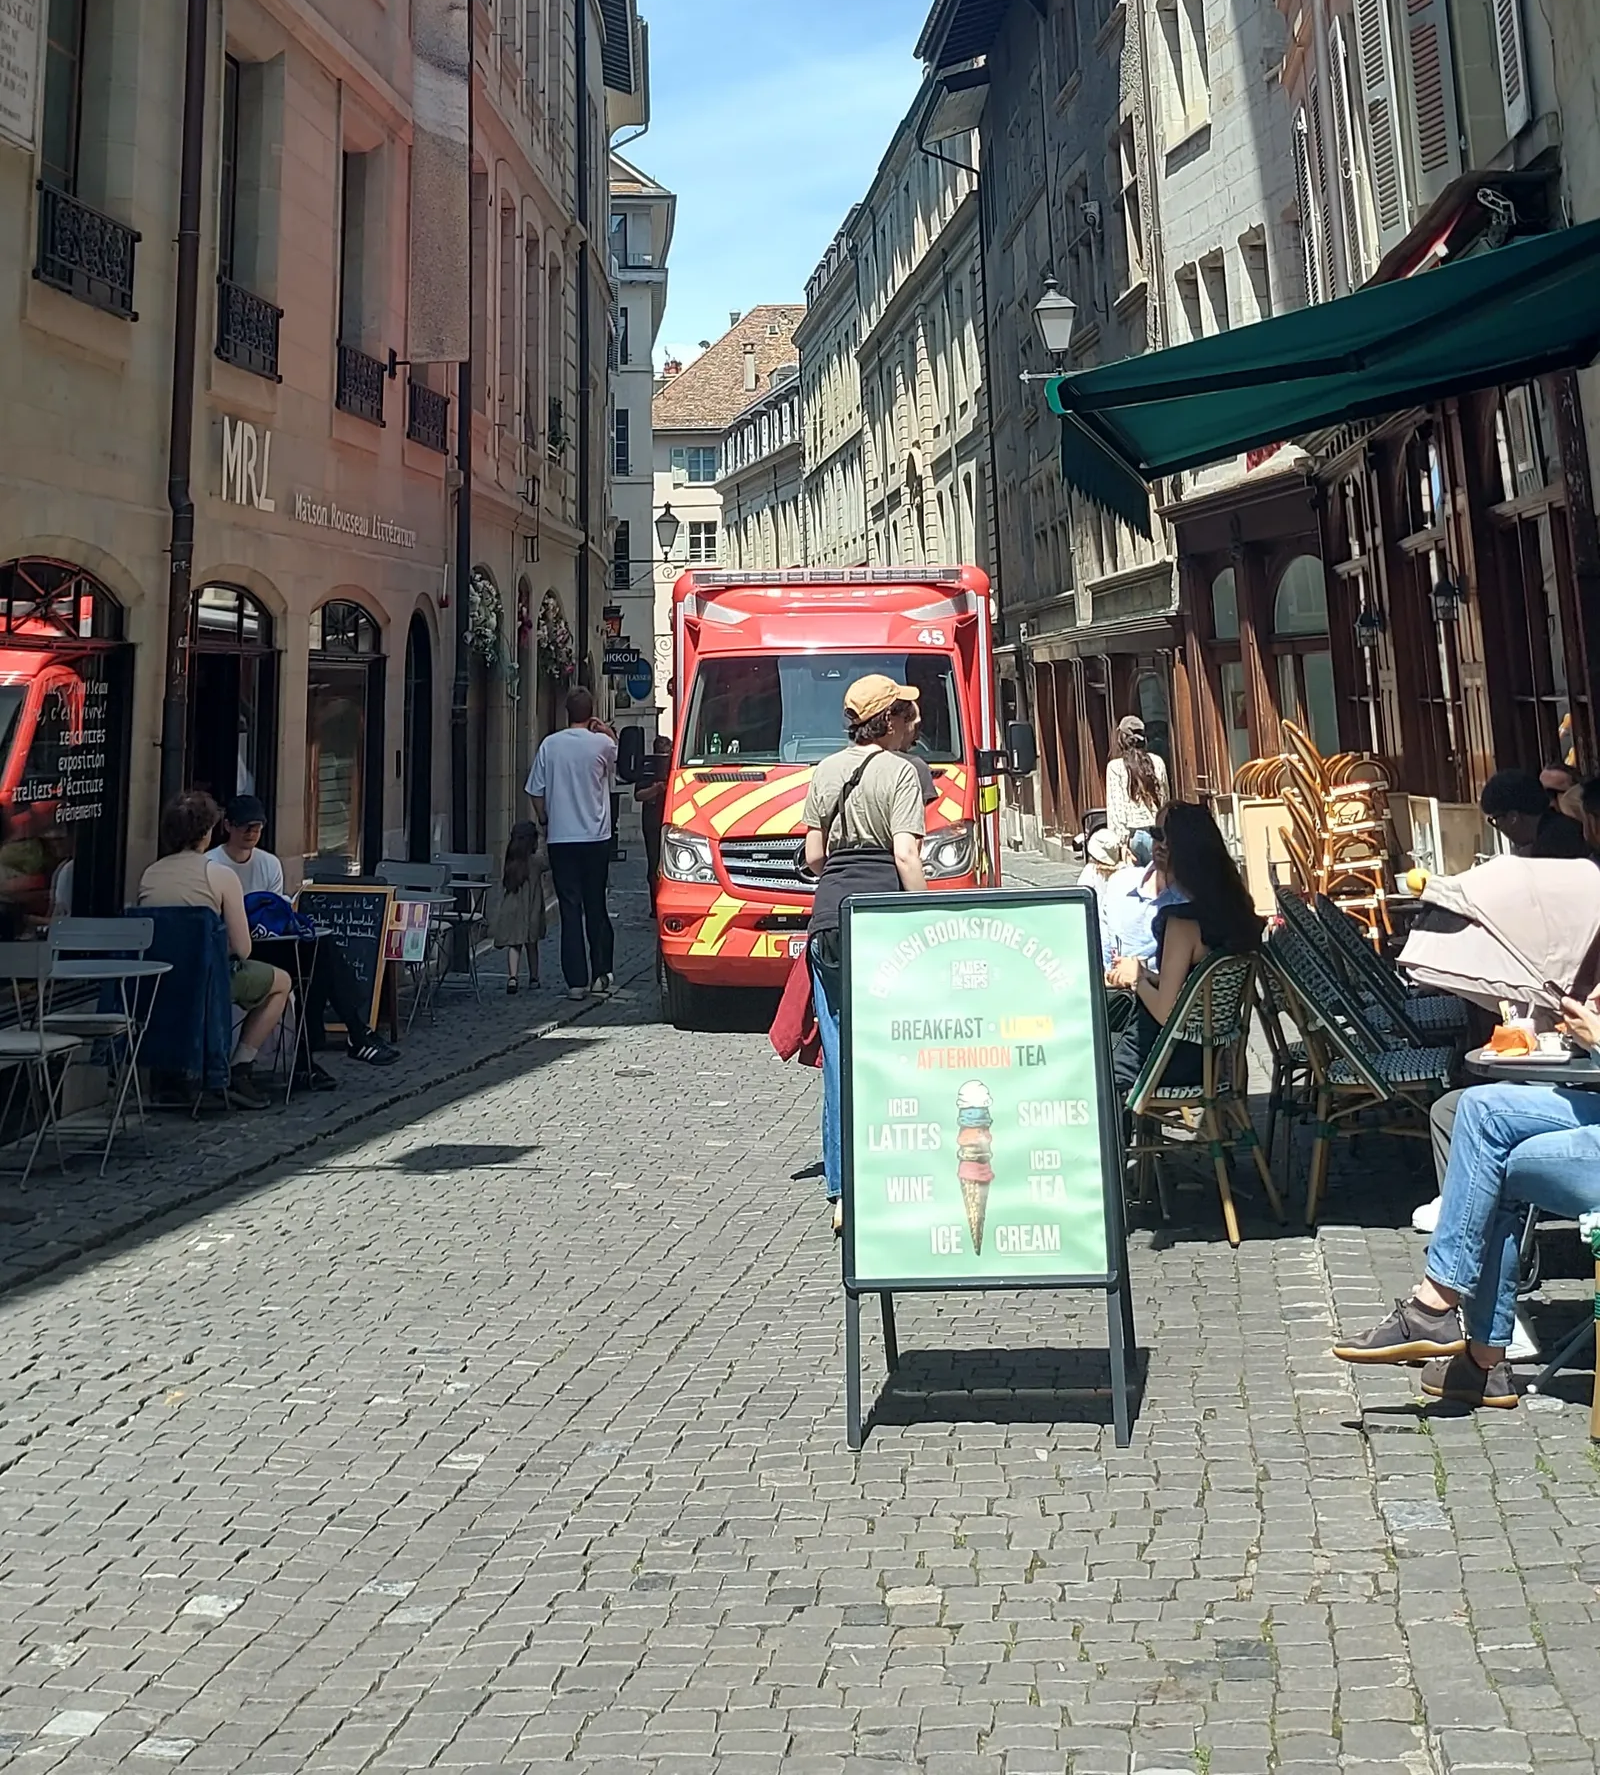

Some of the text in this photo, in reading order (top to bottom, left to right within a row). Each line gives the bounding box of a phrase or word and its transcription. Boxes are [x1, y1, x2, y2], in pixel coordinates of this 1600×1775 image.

[221, 416, 276, 513] MRL
[295, 493, 417, 549] Maison Rousseau Littérature
[917, 628, 946, 645] 45
[59, 729, 106, 745] rencontres
[58, 750, 105, 776] exposition
[11, 776, 104, 802] ateliers d'écriture
[869, 932, 927, 998] EGLISH
[923, 917, 1025, 950] BOOKSTORE
[1022, 937, 1039, 959] &
[891, 1018, 983, 1041] BREAKFAST
[917, 1045, 1047, 1069] AFTERNOON TEA
[888, 1098, 919, 1117] ICED
[1017, 1099, 1090, 1126] SCONES
[868, 1123, 942, 1152] LATTES
[1029, 1149, 1062, 1170] ICED
[886, 1176, 934, 1203] WINE
[1028, 1175, 1068, 1202] TEA
[930, 1225, 1061, 1255] ICE CREAM
